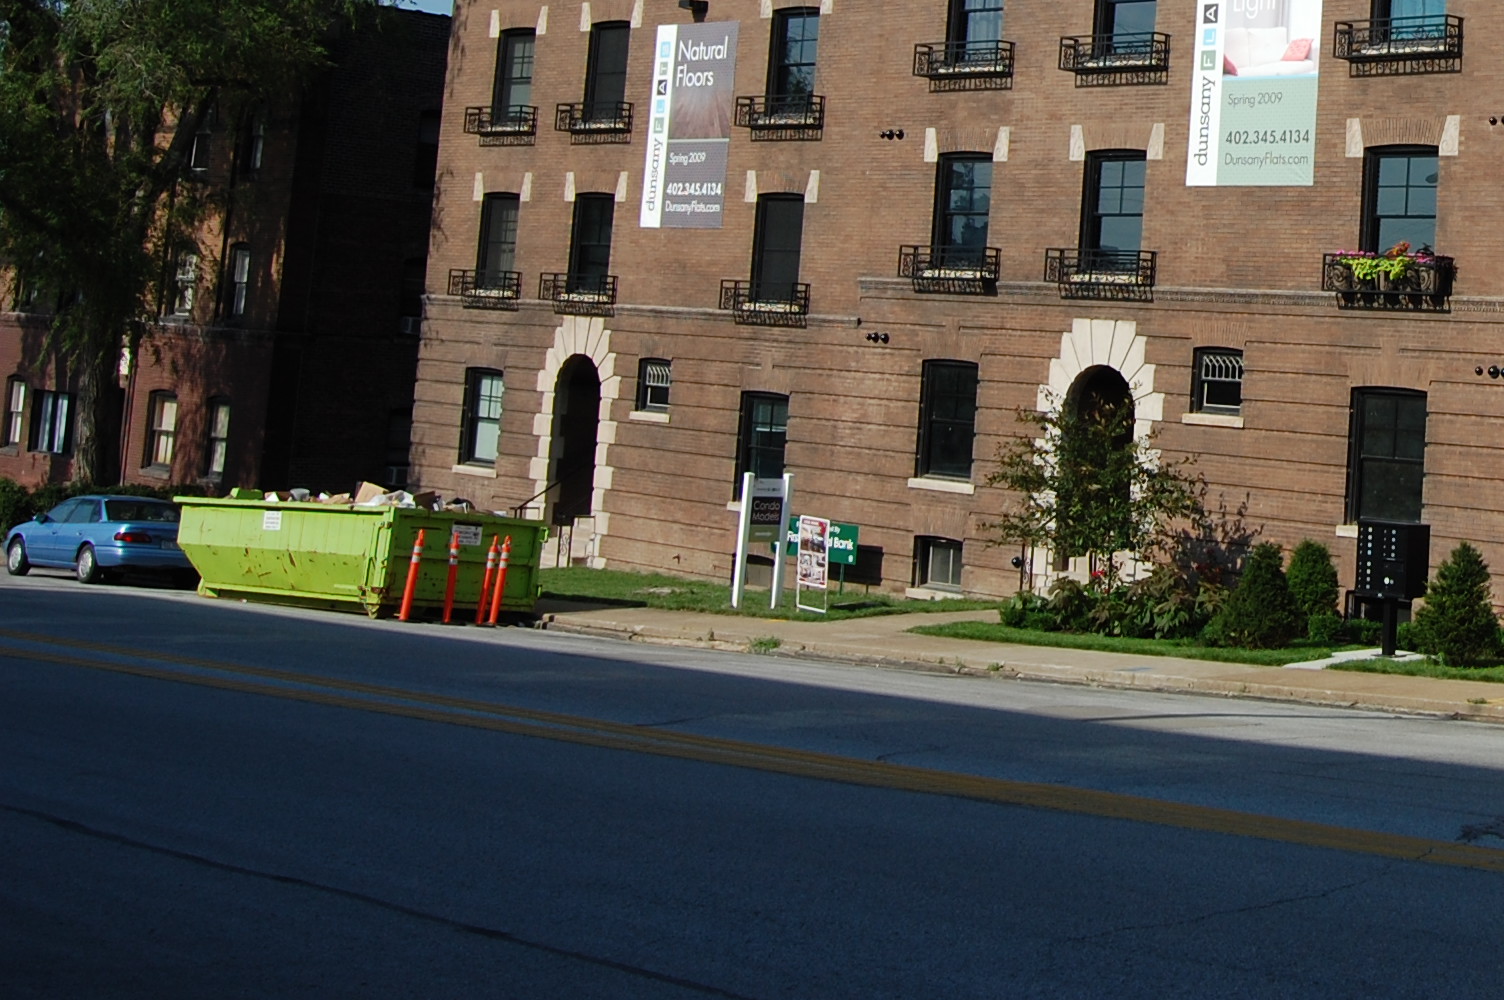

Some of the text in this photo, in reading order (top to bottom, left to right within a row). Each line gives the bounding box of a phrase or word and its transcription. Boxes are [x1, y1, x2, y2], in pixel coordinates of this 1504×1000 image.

[678, 35, 729, 61] Natural
[676, 65, 714, 87] Floors
[1228, 91, 1283, 109] Spring 2009
[1194, 75, 1216, 166] dunsany
[1225, 129, 1309, 145] 402.345.4134
[1224, 151, 1309, 169] DunsanyFlats.com
[645, 138, 664, 211] dunsany
[666, 182, 722, 196] 402.345.4134
